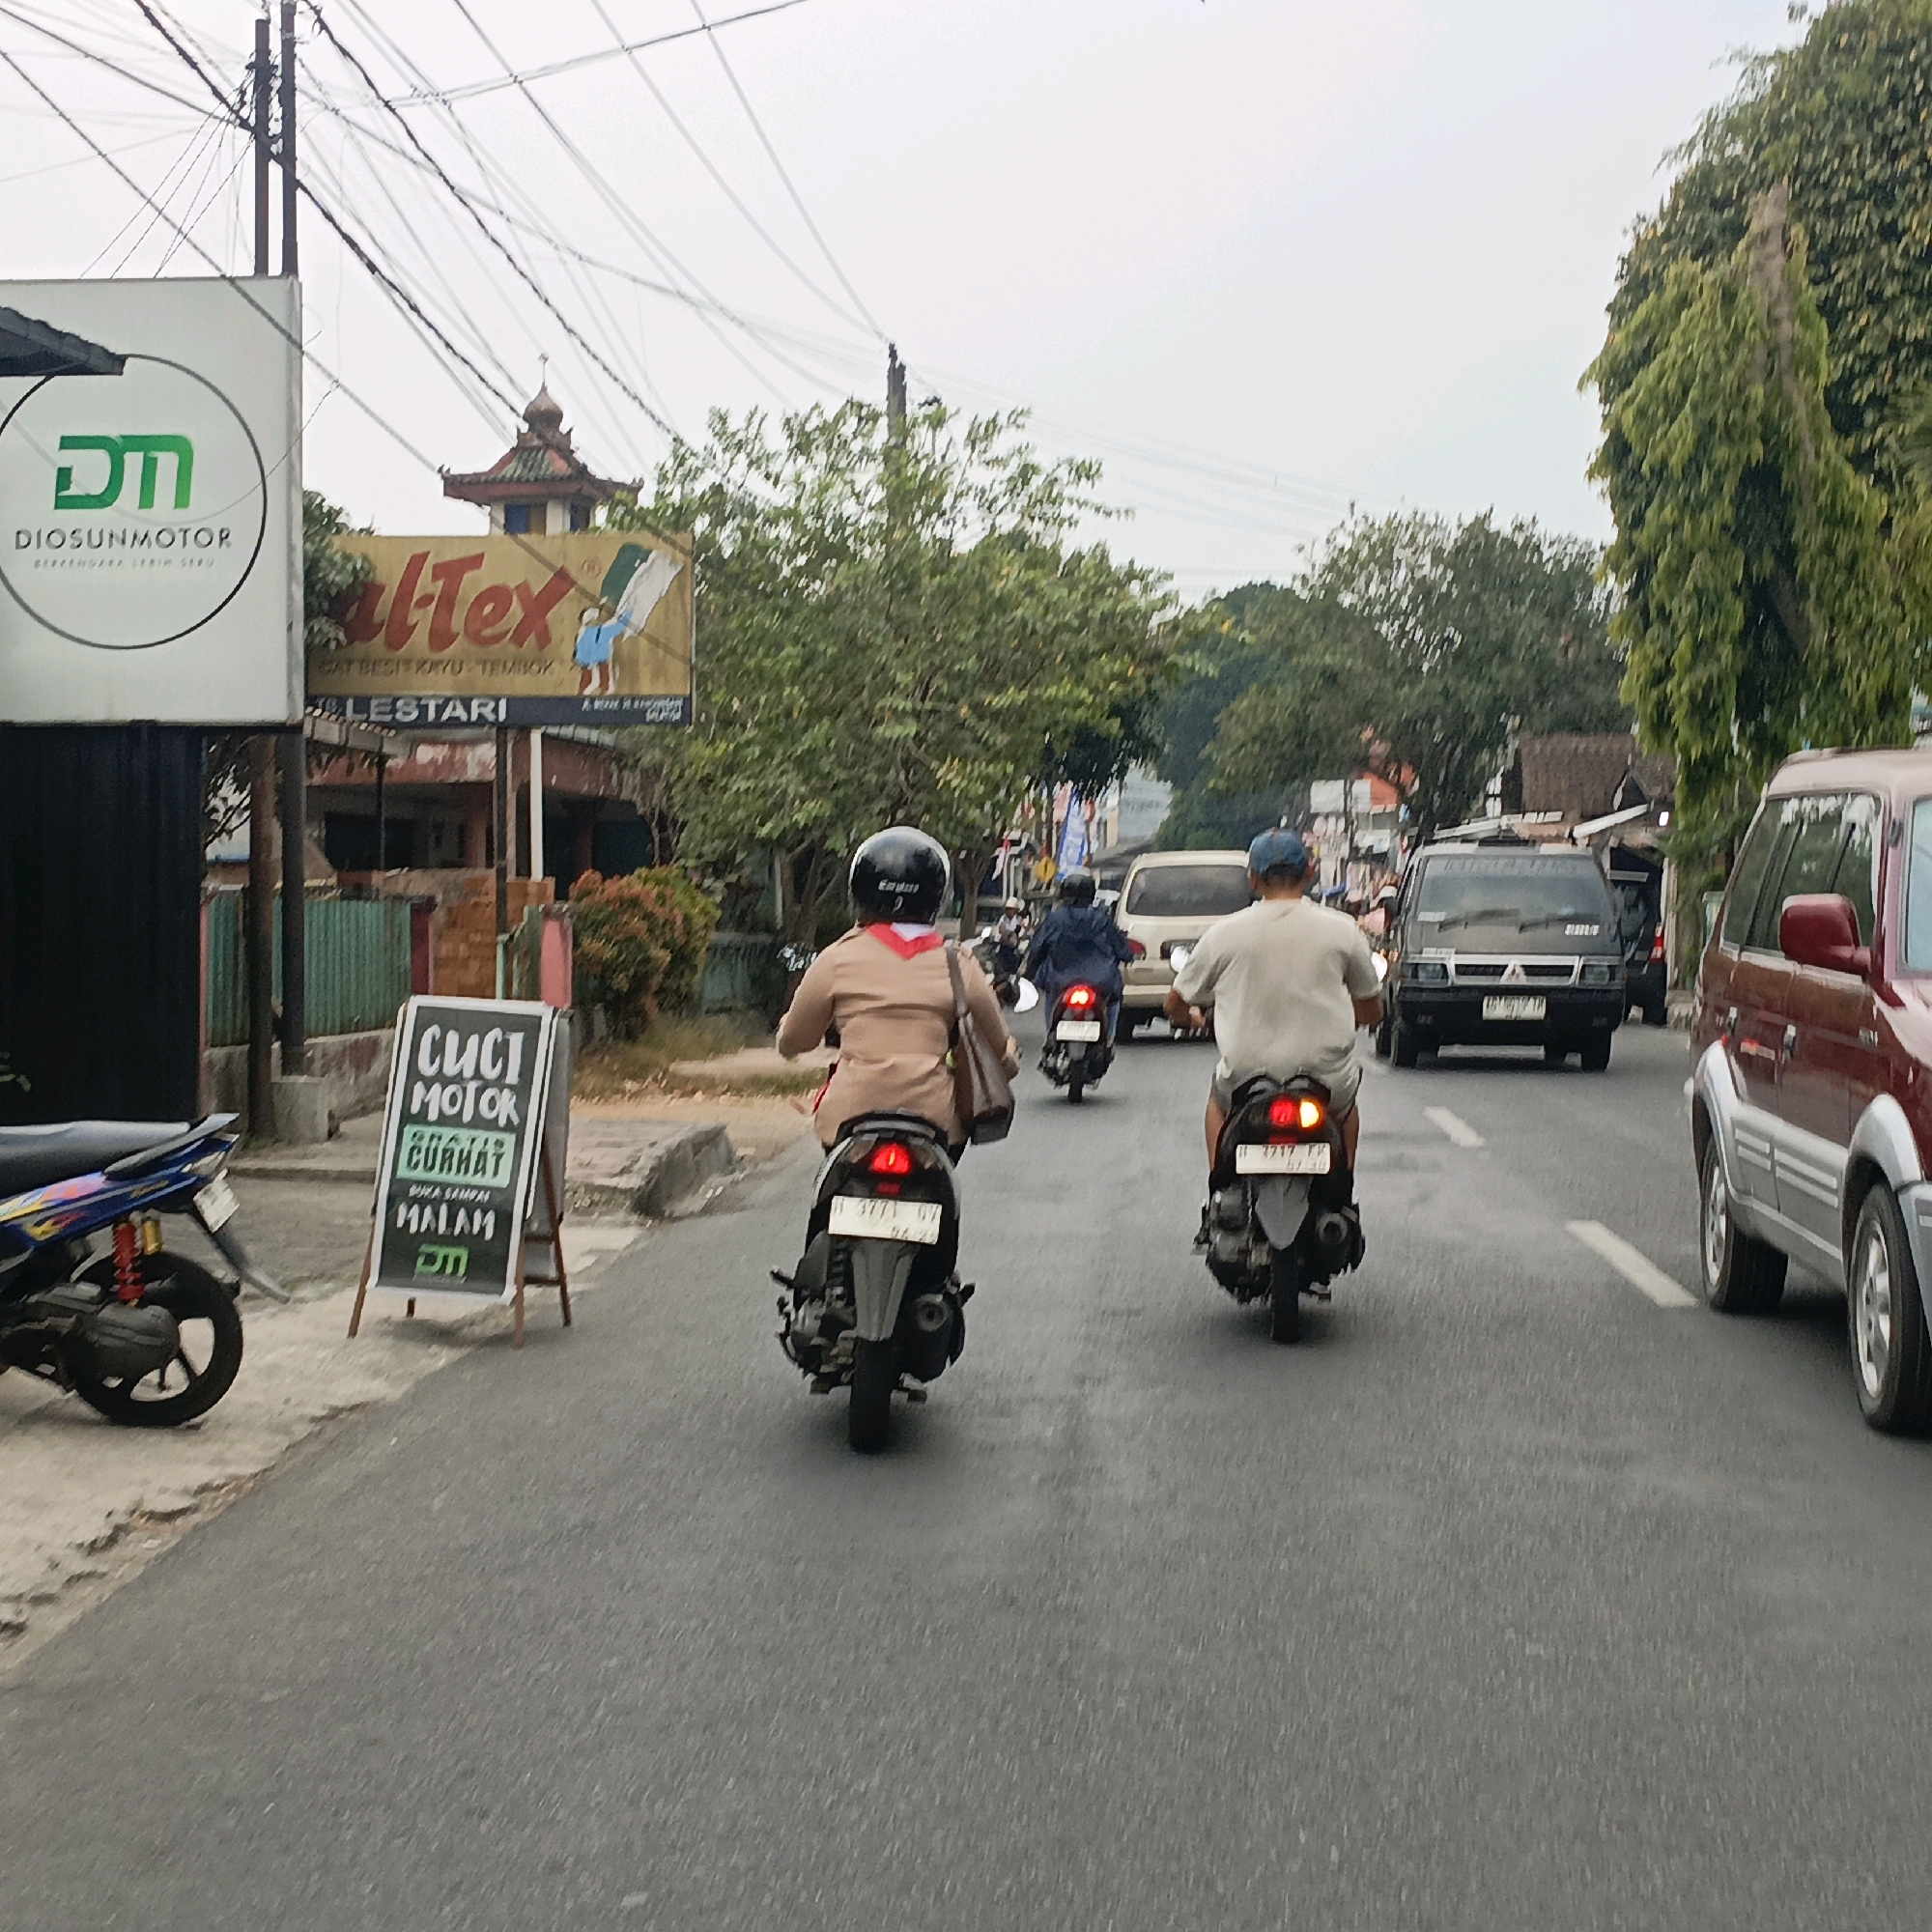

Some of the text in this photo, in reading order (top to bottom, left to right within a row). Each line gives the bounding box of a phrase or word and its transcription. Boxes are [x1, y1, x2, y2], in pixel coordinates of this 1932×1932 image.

[14, 526, 232, 550] DIOSUNMOTOR
[346, 696, 507, 723] LESTARI
[417, 1024, 525, 1085] CUCI
[410, 1080, 520, 1127] MOTOR
[396, 1201, 496, 1241] MALAM
